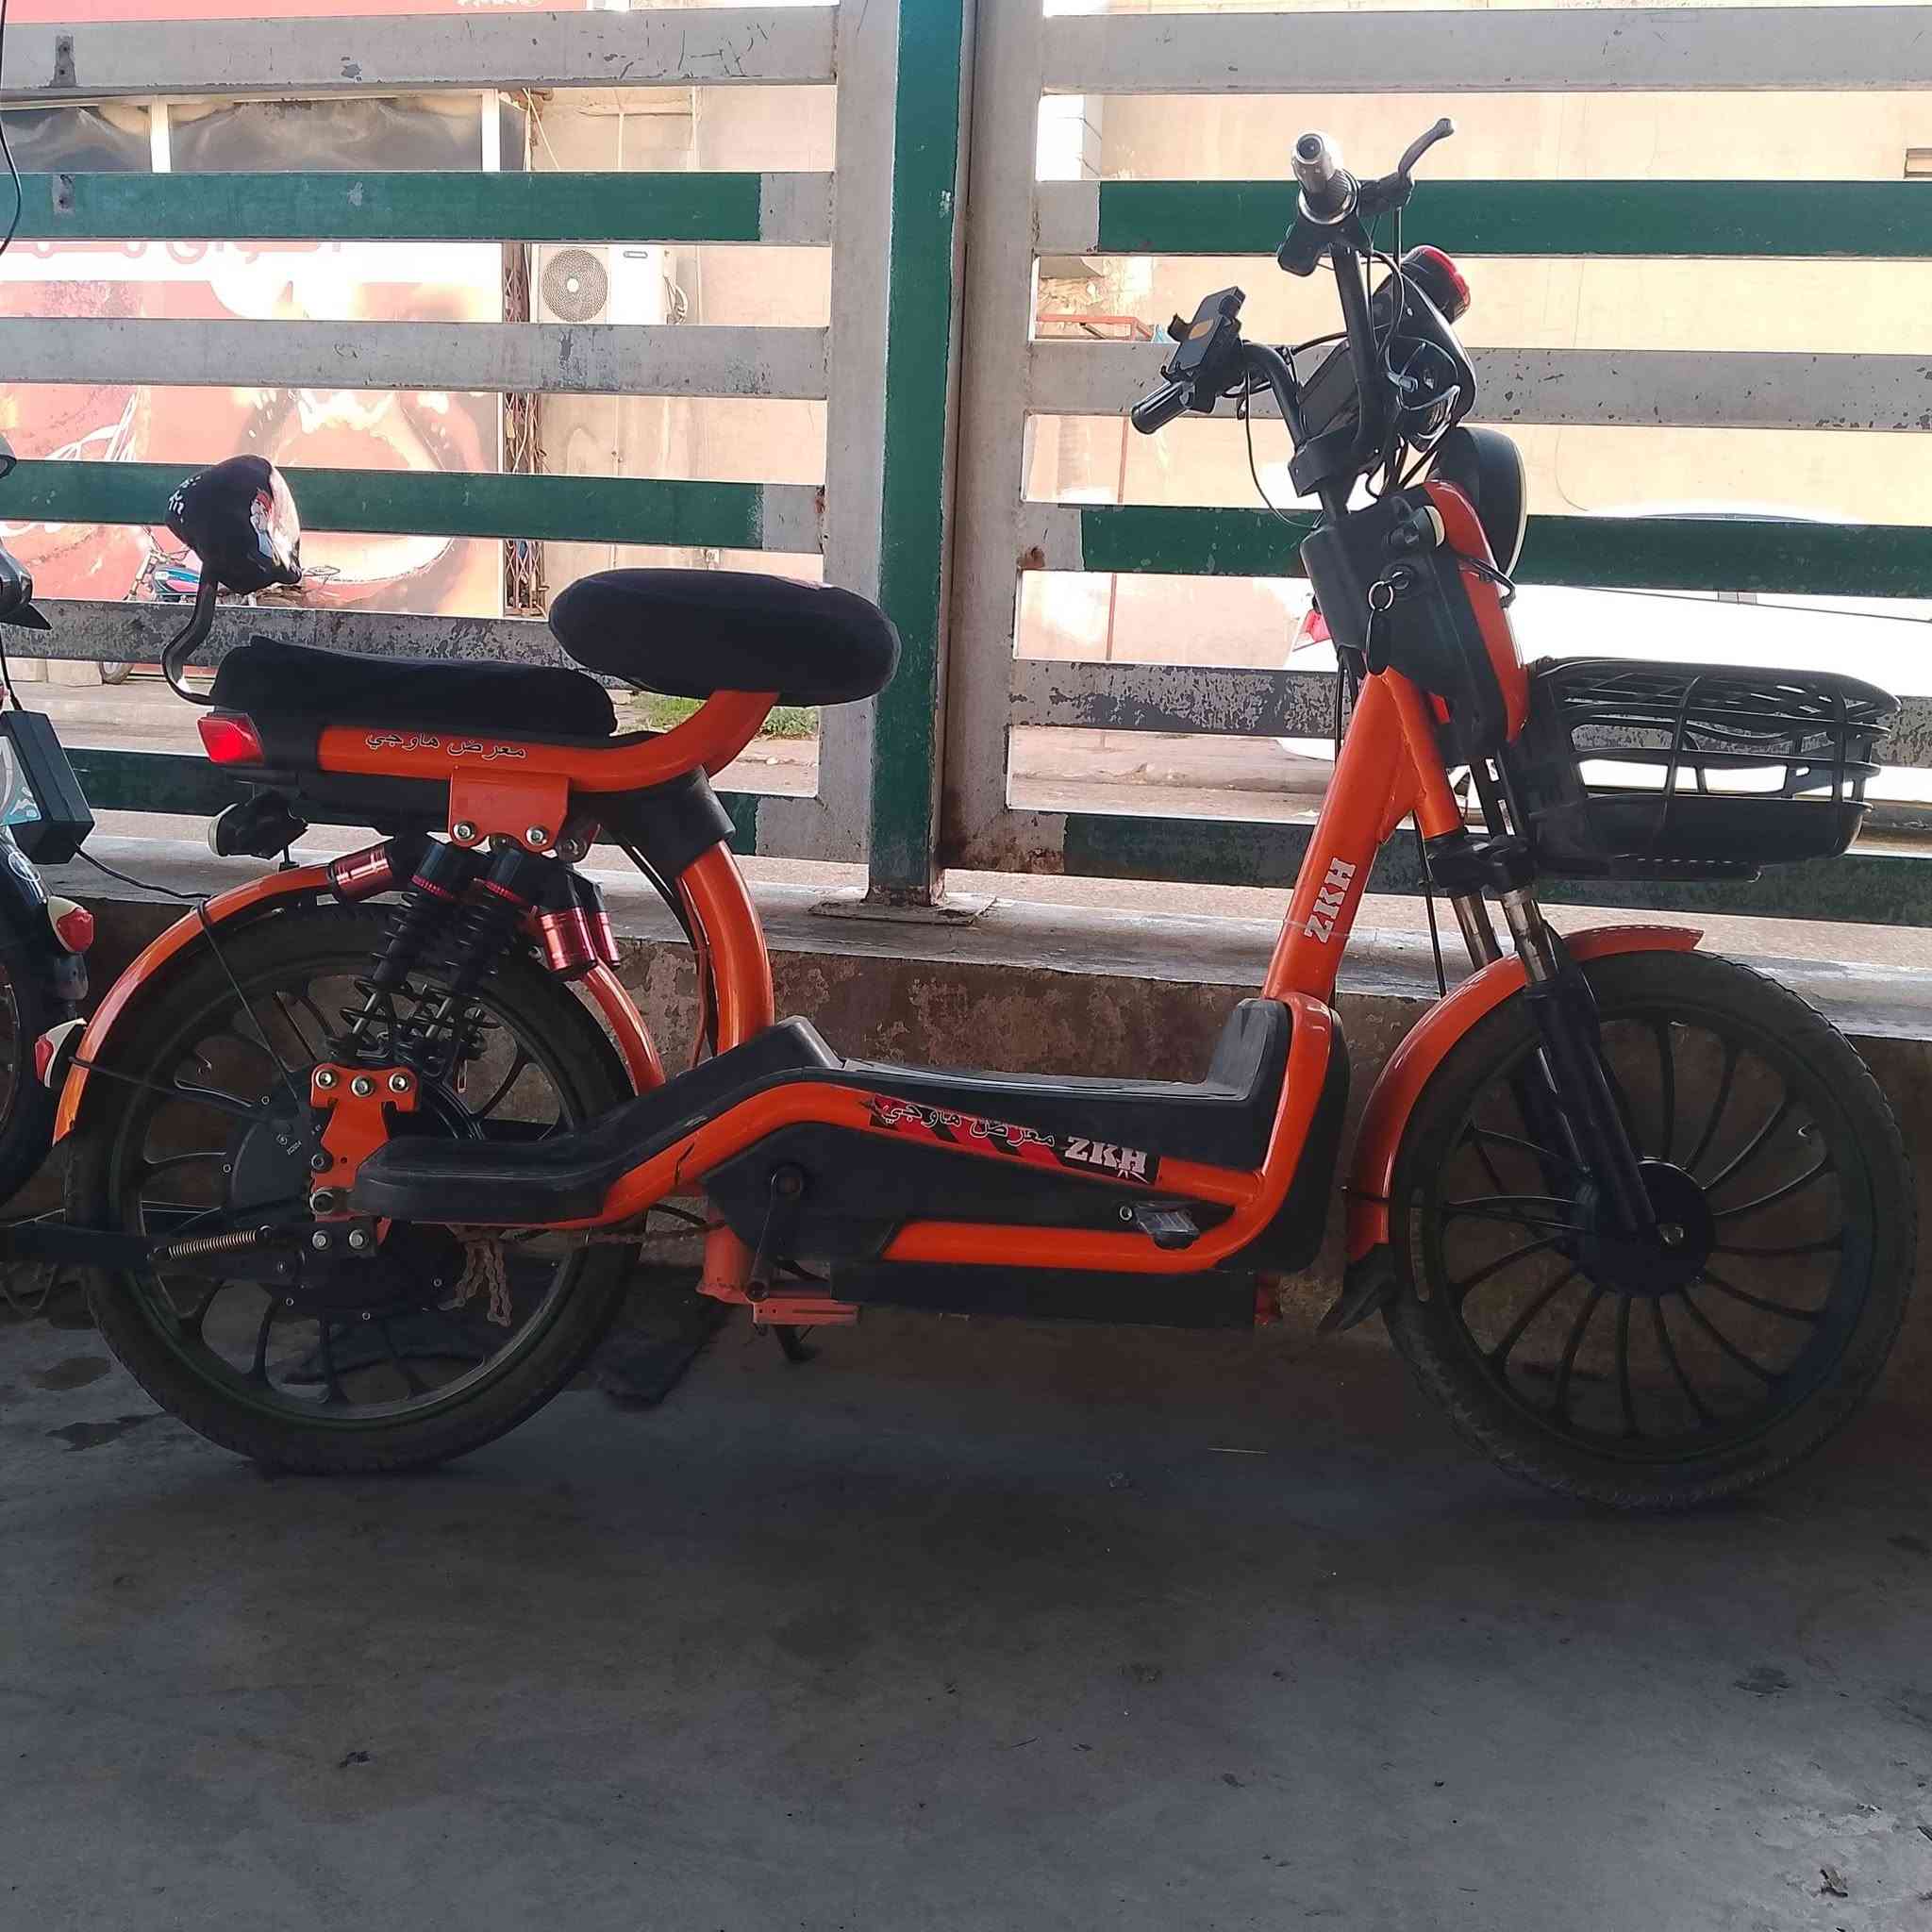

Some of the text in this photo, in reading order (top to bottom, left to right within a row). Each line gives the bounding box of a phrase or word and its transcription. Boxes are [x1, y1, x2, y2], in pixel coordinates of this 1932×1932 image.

[447, 740, 525, 760] معرض
[1304, 857, 1356, 943] ZKH
[970, 1120, 1056, 1148] معرض
[1064, 1135, 1148, 1174] ZKH
